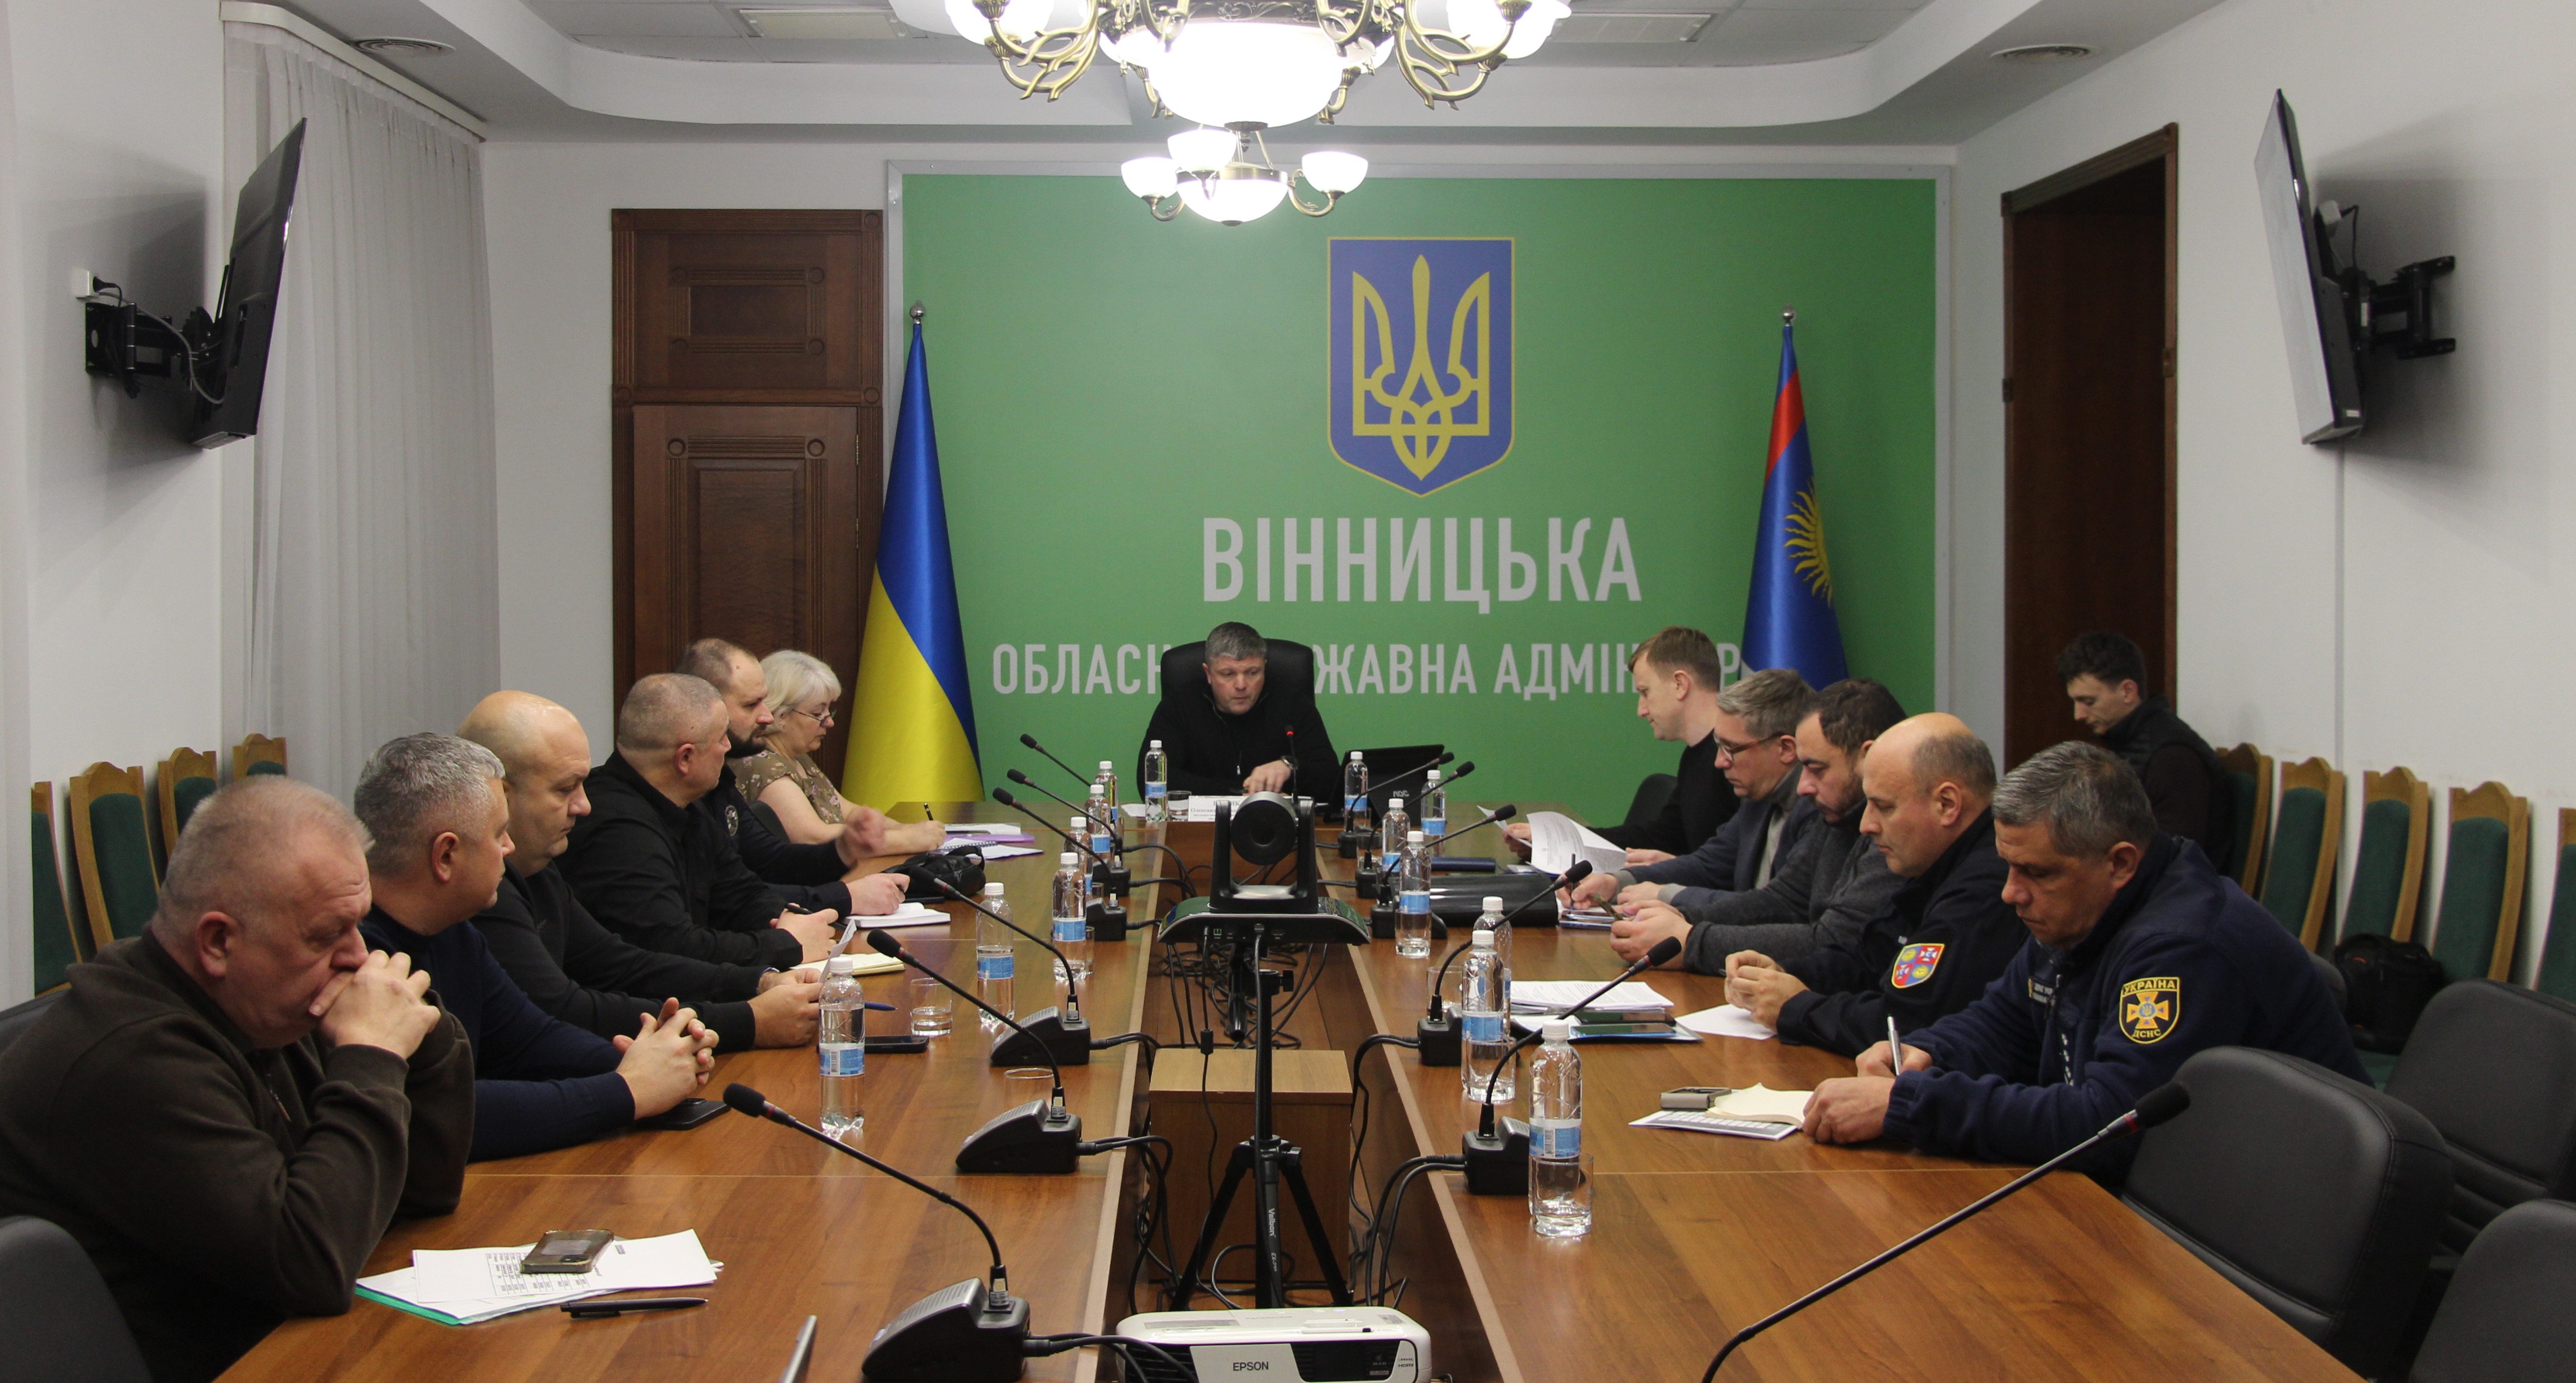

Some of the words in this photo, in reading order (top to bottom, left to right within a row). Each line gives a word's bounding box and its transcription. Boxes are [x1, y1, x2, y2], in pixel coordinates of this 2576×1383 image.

[1203, 517, 1642, 614] ВІННИЦЬКА
[993, 643, 1162, 694] ОБЛАСН
[1312, 643, 1477, 694] ЖАВНА
[2123, 978, 2176, 994] УКРАЇНА
[2132, 1029, 2161, 1039] ДСНС
[1233, 1361, 1269, 1371] EPSON
